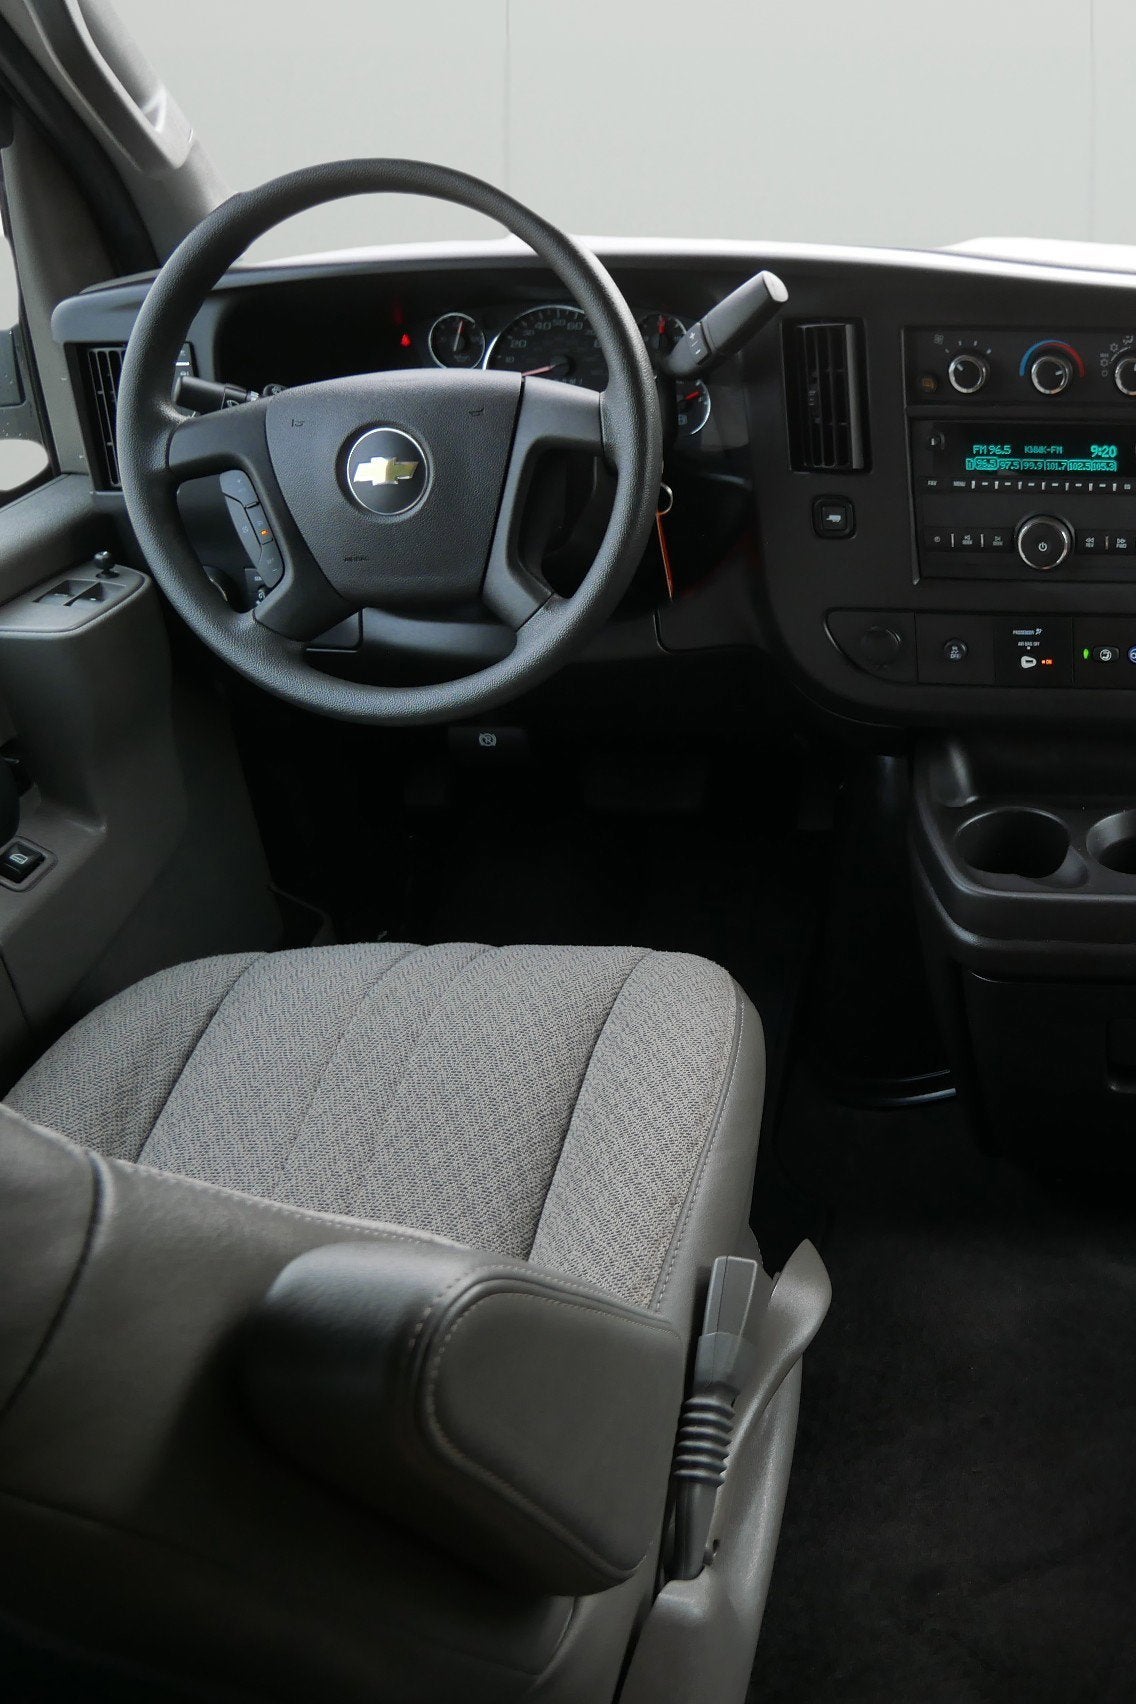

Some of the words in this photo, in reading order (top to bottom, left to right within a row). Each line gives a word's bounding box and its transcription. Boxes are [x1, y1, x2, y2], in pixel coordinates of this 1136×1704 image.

[973, 445, 987, 455] FM
[988, 445, 1012, 455] 96.5
[1090, 444, 1118, 458] 9:20
[976, 459, 997, 469] 96.5
[999, 460, 1020, 470] 97.5
[1023, 461, 1043, 470] 99.9
[1046, 461, 1068, 471] 101.7
[1069, 461, 1091, 471] 102.5
[1092, 461, 1116, 471] 105.3
